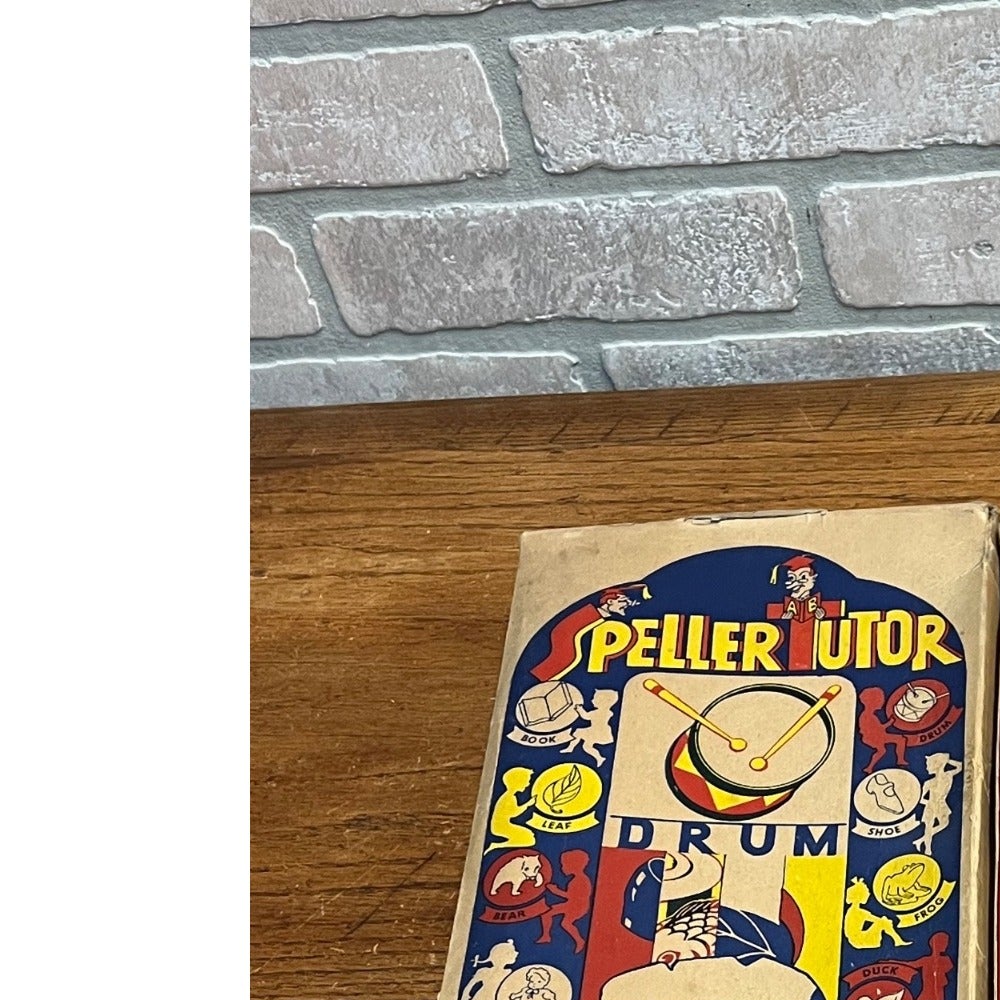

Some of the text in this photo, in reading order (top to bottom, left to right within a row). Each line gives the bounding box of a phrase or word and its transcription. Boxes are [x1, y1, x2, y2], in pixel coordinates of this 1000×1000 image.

[530, 600, 963, 682] SPELLER TUTOR
[919, 719, 952, 744] DRUM
[520, 734, 557, 745] BOOK
[541, 820, 572, 831] LEAF
[867, 825, 902, 836] SHOE
[618, 817, 838, 857] DRUM
[492, 910, 526, 920] BEAR
[913, 896, 945, 922] FROG
[862, 966, 900, 978] DUCK
